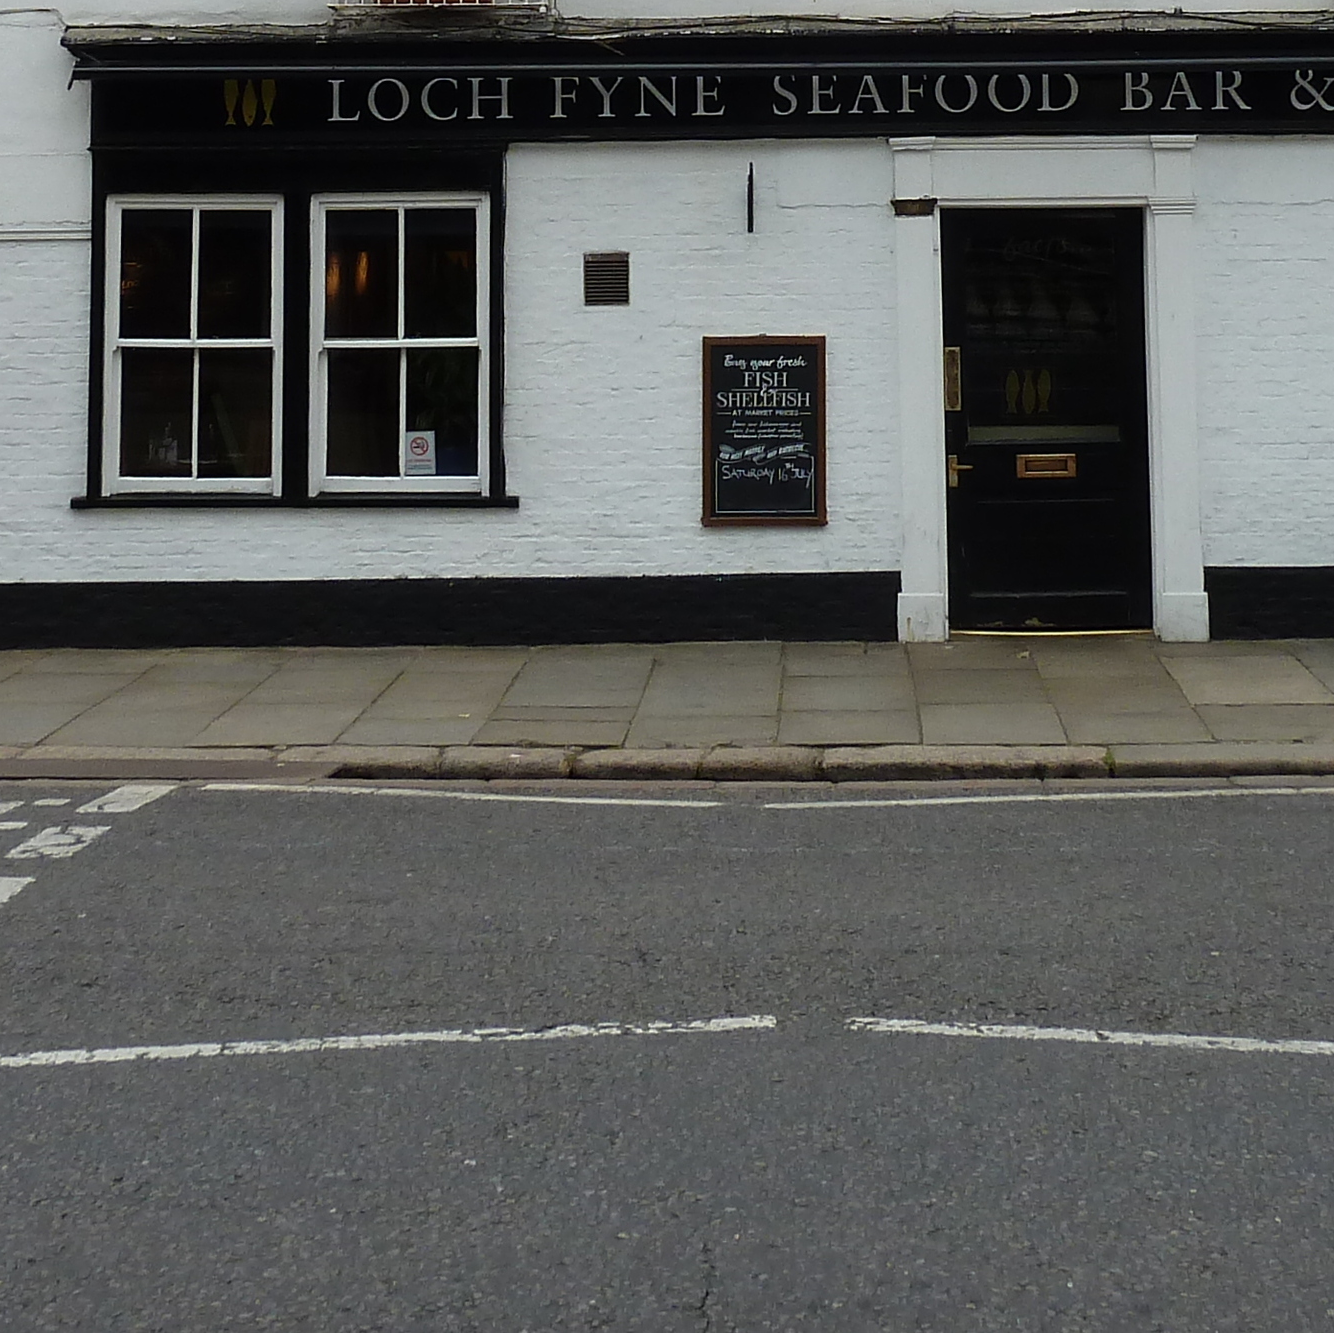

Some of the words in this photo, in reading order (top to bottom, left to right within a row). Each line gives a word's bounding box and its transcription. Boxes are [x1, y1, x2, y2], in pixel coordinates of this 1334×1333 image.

[327, 76, 515, 122] LOCH
[549, 75, 725, 119] FYNE
[771, 71, 1080, 116] SEAFOOD
[1119, 68, 1254, 112] BAR
[743, 371, 788, 387] FISH
[717, 391, 811, 408] SHELLFISH
